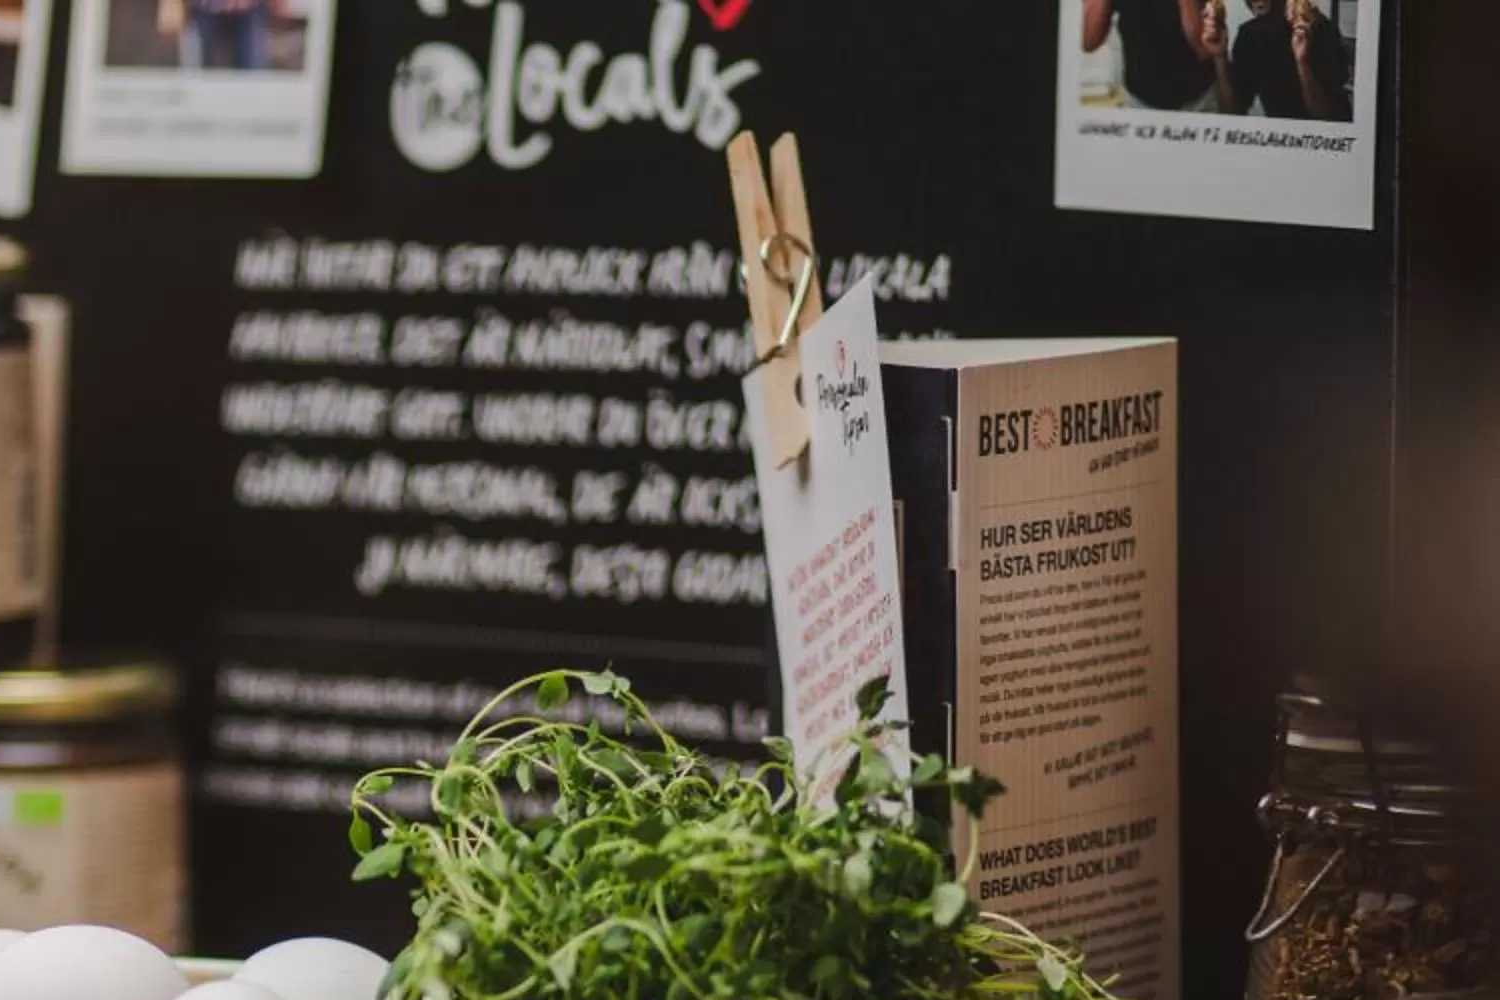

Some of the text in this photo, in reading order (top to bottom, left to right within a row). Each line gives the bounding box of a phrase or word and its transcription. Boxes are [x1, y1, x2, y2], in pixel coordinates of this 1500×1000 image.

[979, 409, 1033, 457] BEST
[1060, 390, 1164, 447] BREAKFAST
[980, 506, 1133, 549] HUR SER VÄRLDENS
[980, 552, 1034, 581] BÄSTA
[1036, 542, 1110, 573] FRUKOST
[980, 845, 1022, 871] WHAT
[1025, 837, 1066, 865] DOES
[980, 866, 1064, 900] BREAKFAST
[1067, 858, 1106, 883] LOOK
